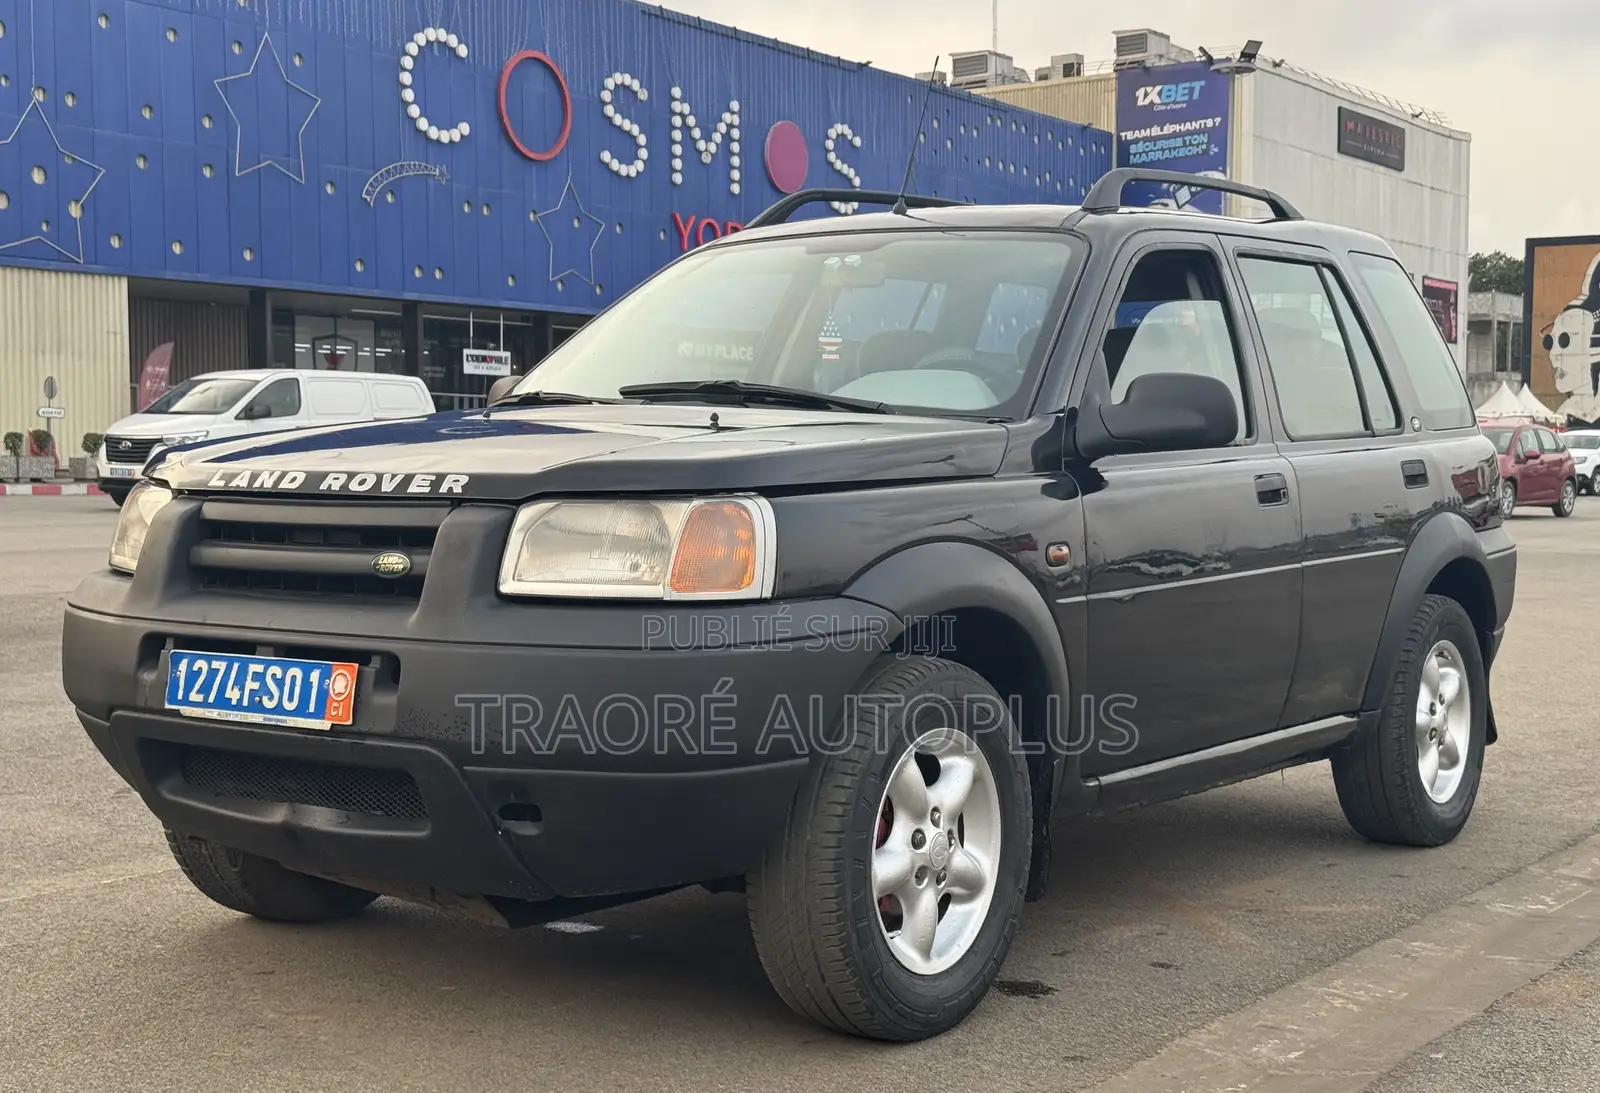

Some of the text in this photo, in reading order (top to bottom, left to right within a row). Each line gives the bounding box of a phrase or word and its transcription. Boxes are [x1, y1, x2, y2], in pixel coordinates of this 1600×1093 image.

[1135, 80, 1206, 107] 1XBET
[400, 27, 862, 215] COSMOS
[1120, 129, 1150, 141] TEAM
[1184, 133, 1208, 145] TON
[207, 470, 470, 494] LAND ROVER
[378, 556, 399, 564] LAND
[379, 564, 404, 572] ROVER
[177, 658, 321, 713] 1274FS01
[330, 704, 344, 717] CI
